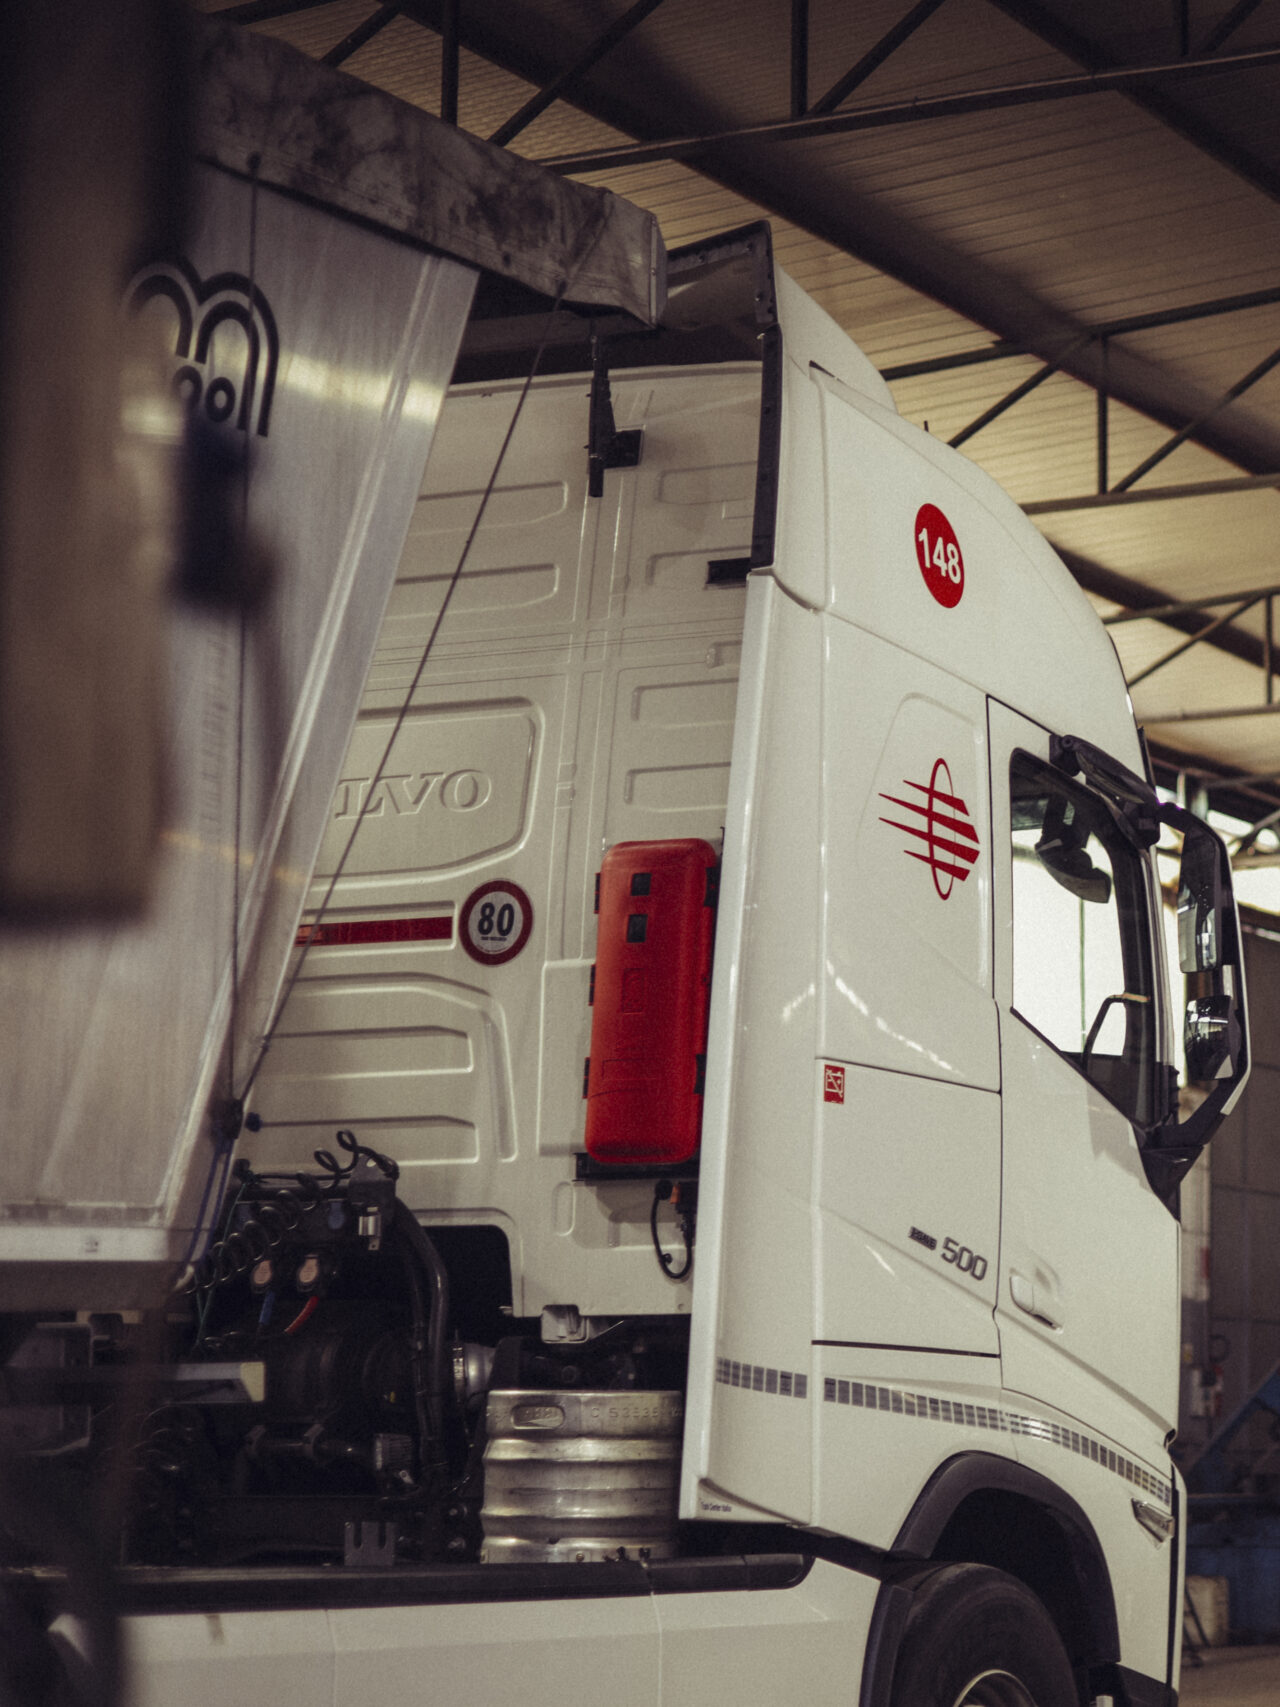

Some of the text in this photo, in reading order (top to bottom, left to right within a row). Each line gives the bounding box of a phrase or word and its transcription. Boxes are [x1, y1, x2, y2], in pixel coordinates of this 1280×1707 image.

[919, 528, 961, 584] 148
[335, 768, 492, 820] LVO
[477, 902, 515, 937] 80
[941, 1236, 988, 1281] 500
